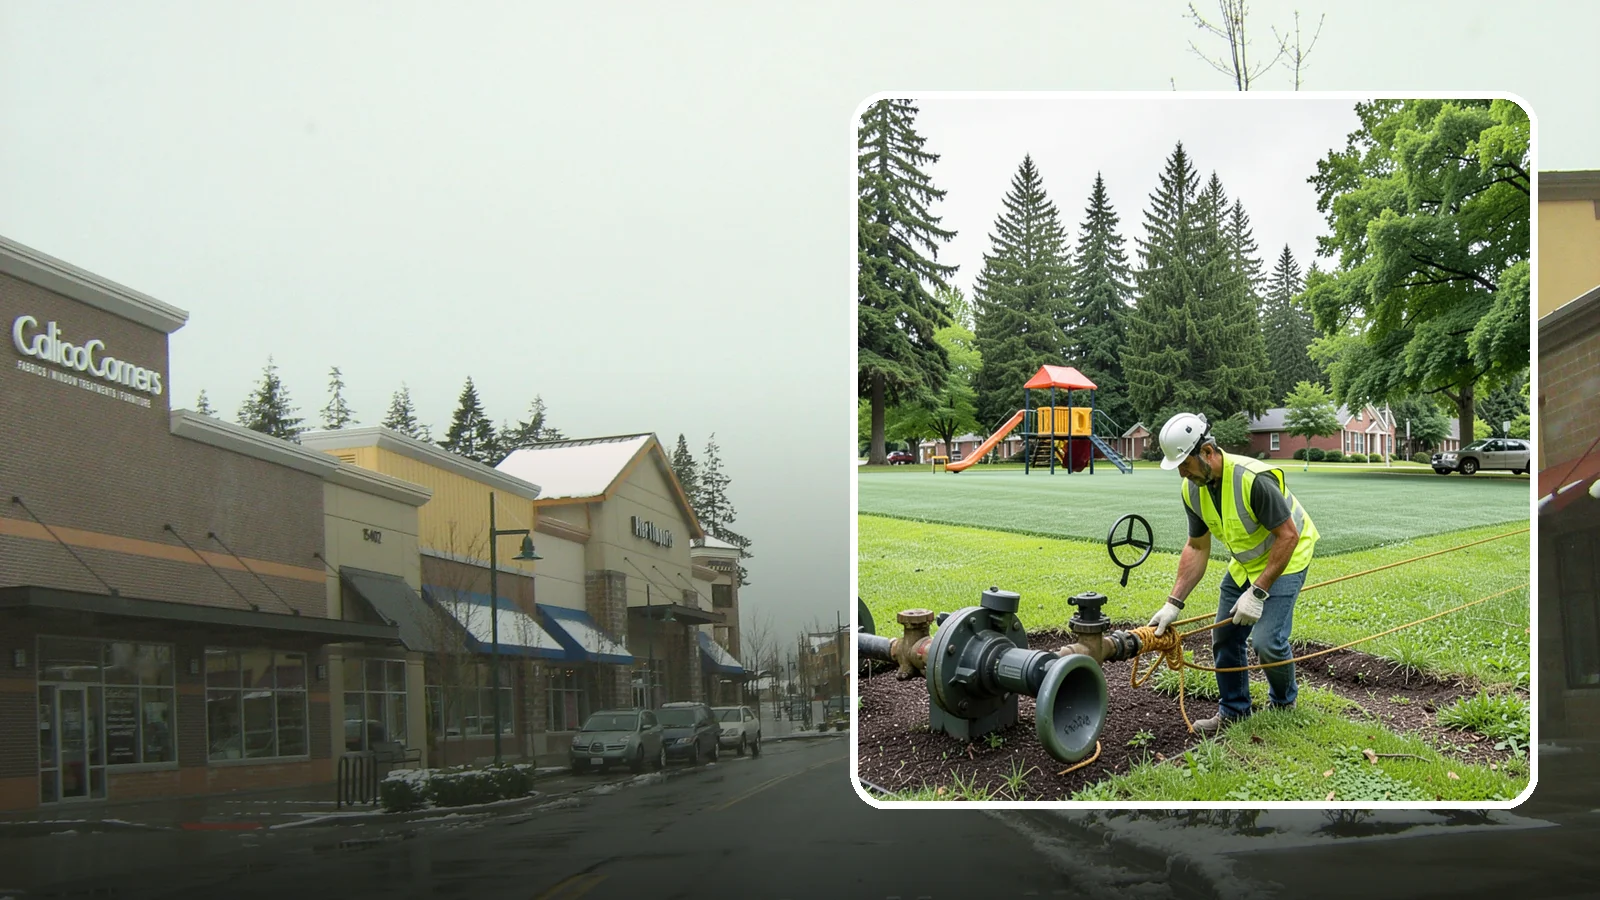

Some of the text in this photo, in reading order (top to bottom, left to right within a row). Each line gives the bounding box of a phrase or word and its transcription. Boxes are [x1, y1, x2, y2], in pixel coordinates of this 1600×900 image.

[16, 360, 46, 377] FABRICS
[51, 370, 77, 386] WINDOW
[79, 378, 116, 398] TREATMENTS
